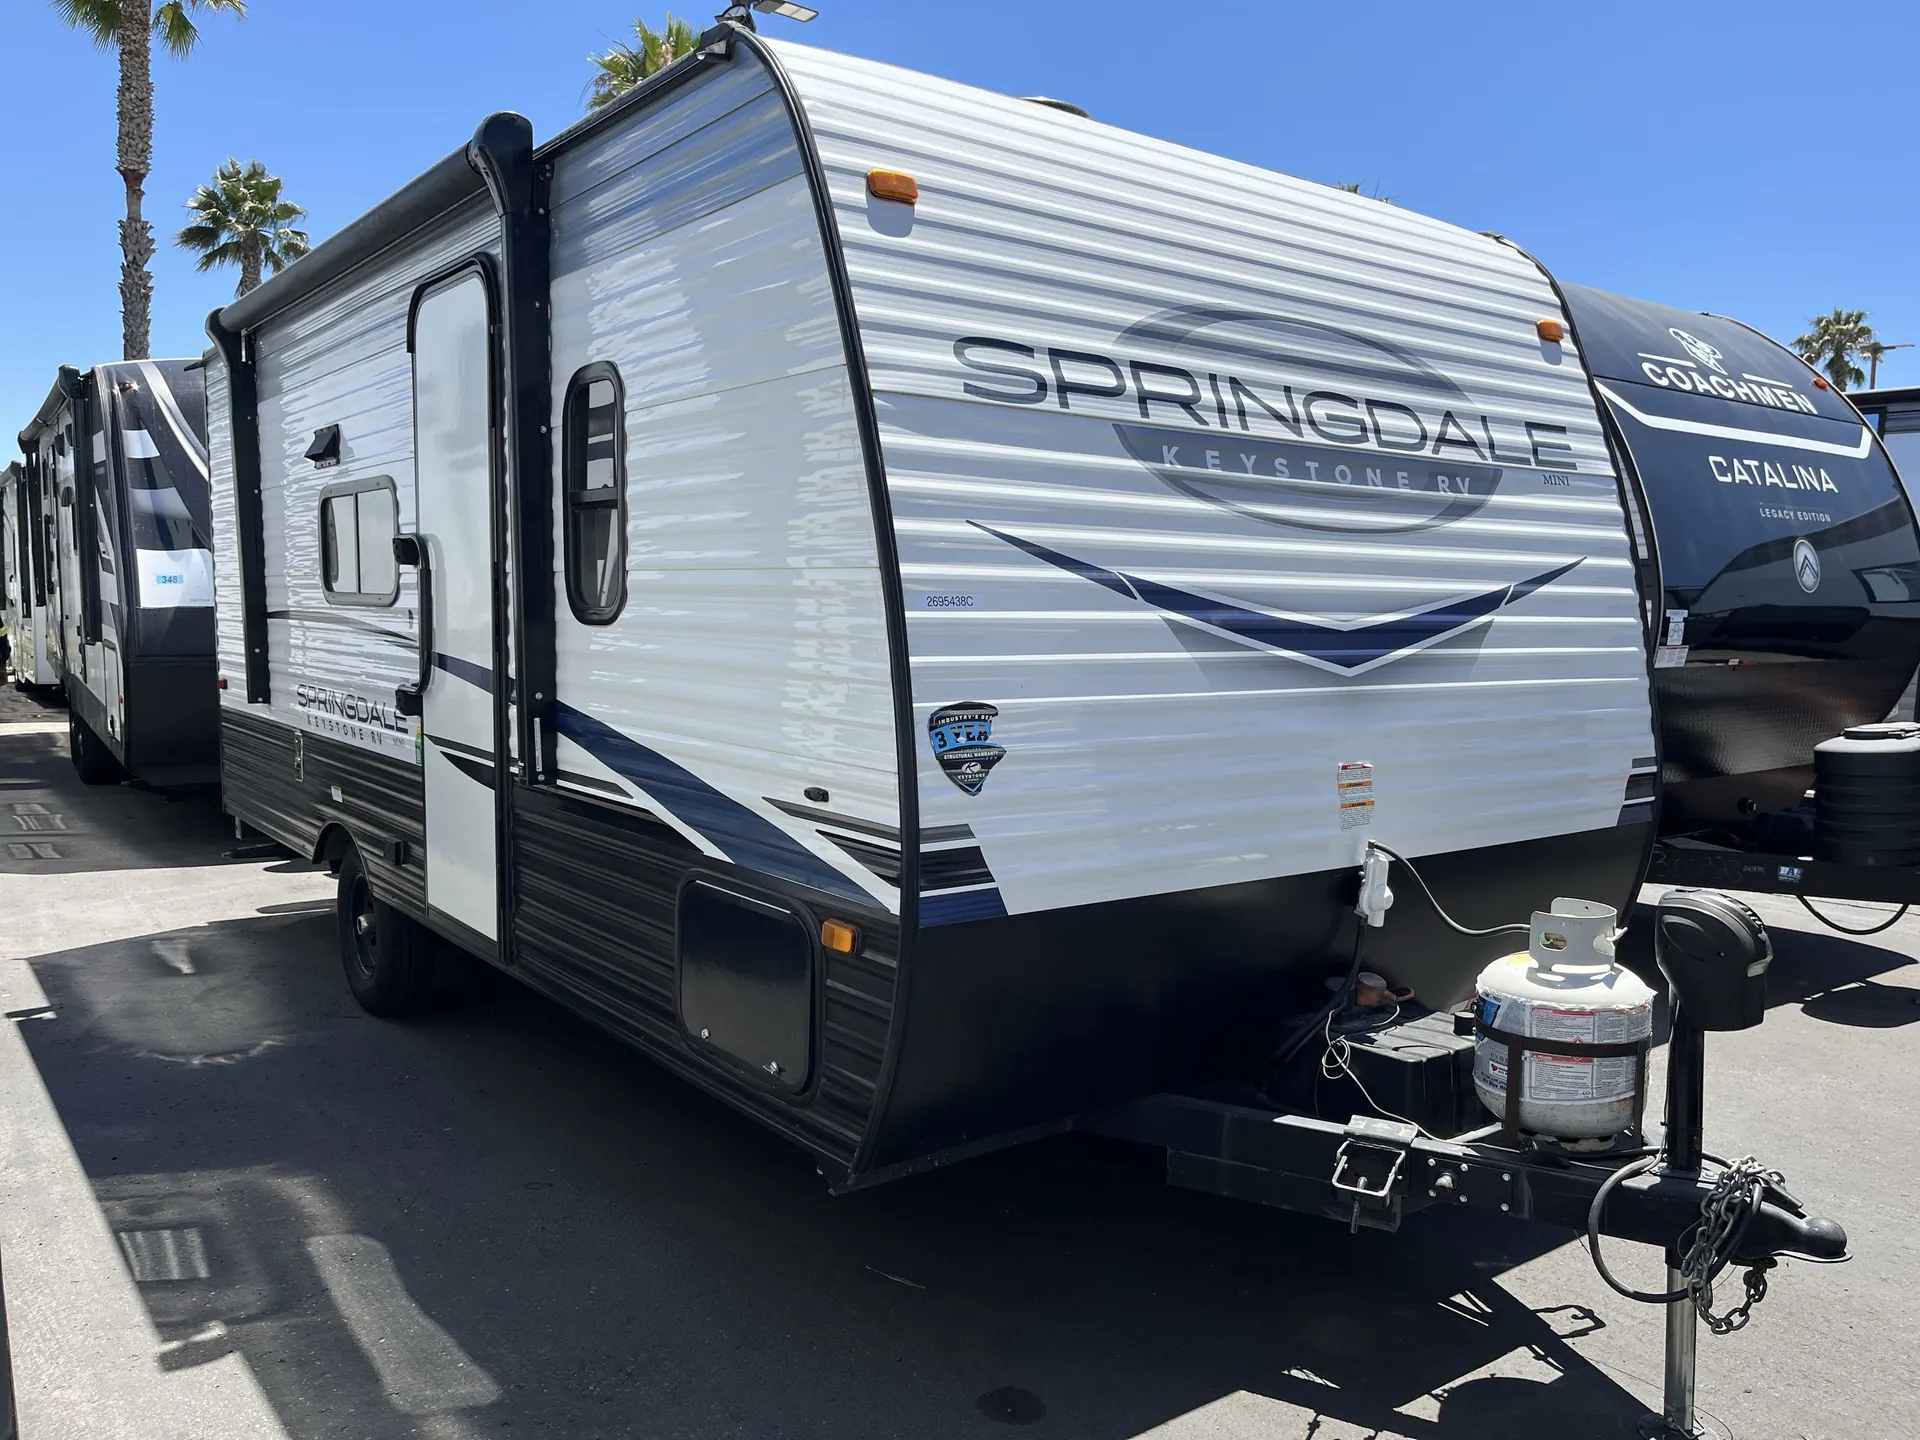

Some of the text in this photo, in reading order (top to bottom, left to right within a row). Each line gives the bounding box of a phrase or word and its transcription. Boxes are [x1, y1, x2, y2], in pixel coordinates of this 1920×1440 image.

[1641, 361, 1818, 415] COACHMEN
[952, 336, 1578, 471] SPRINGDALE
[1162, 444, 1473, 496] KEYSTONE RV
[1542, 473, 1571, 488] MINI
[1707, 455, 1839, 493] CATALINA
[1759, 507, 1832, 524] LEGACY EDITION
[161, 575, 178, 584] 348
[926, 595, 974, 608] 2695438C
[297, 683, 409, 735] SPRINGDALE
[938, 715, 979, 725] INDUSTRY'S
[306, 714, 365, 741] KEYSTONE
[370, 731, 382, 746] RV
[935, 725, 989, 748] 3 YEA
